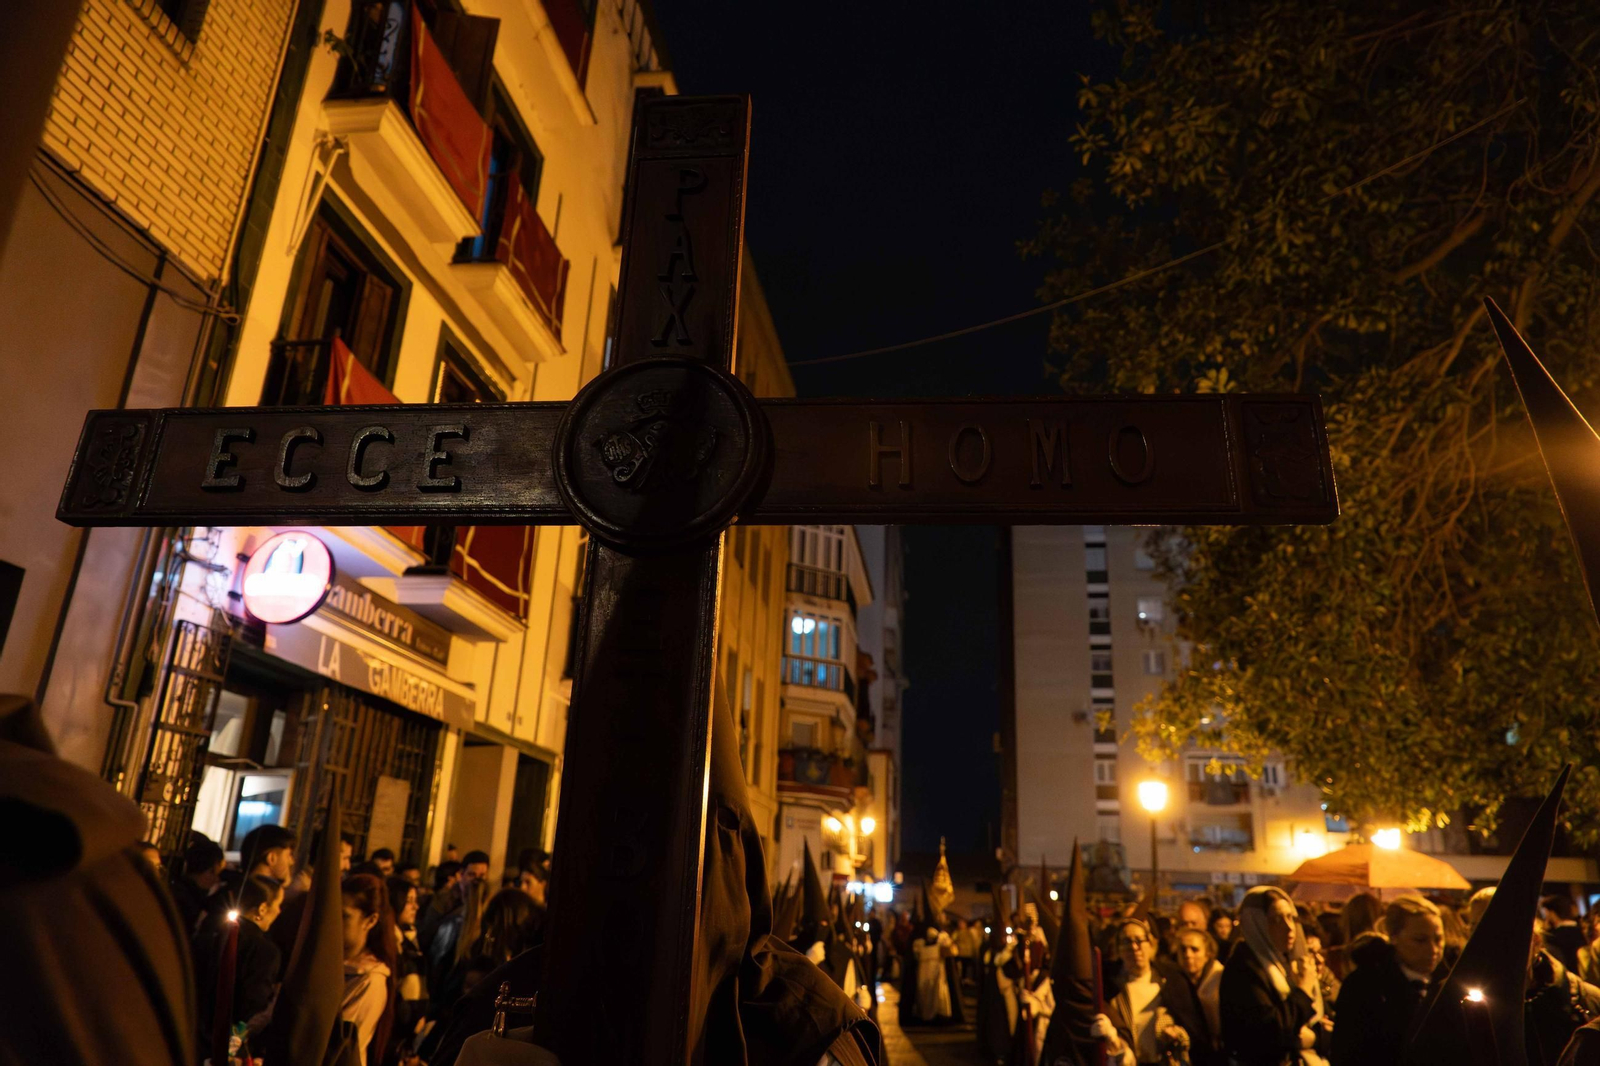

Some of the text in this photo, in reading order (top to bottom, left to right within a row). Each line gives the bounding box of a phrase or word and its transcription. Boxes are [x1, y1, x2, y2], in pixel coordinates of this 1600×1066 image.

[650, 163, 710, 347] PAX
[199, 417, 1155, 493] ECCE HOMO
[326, 585, 414, 645] amberra
[317, 635, 445, 720] LA GAMBERRA
